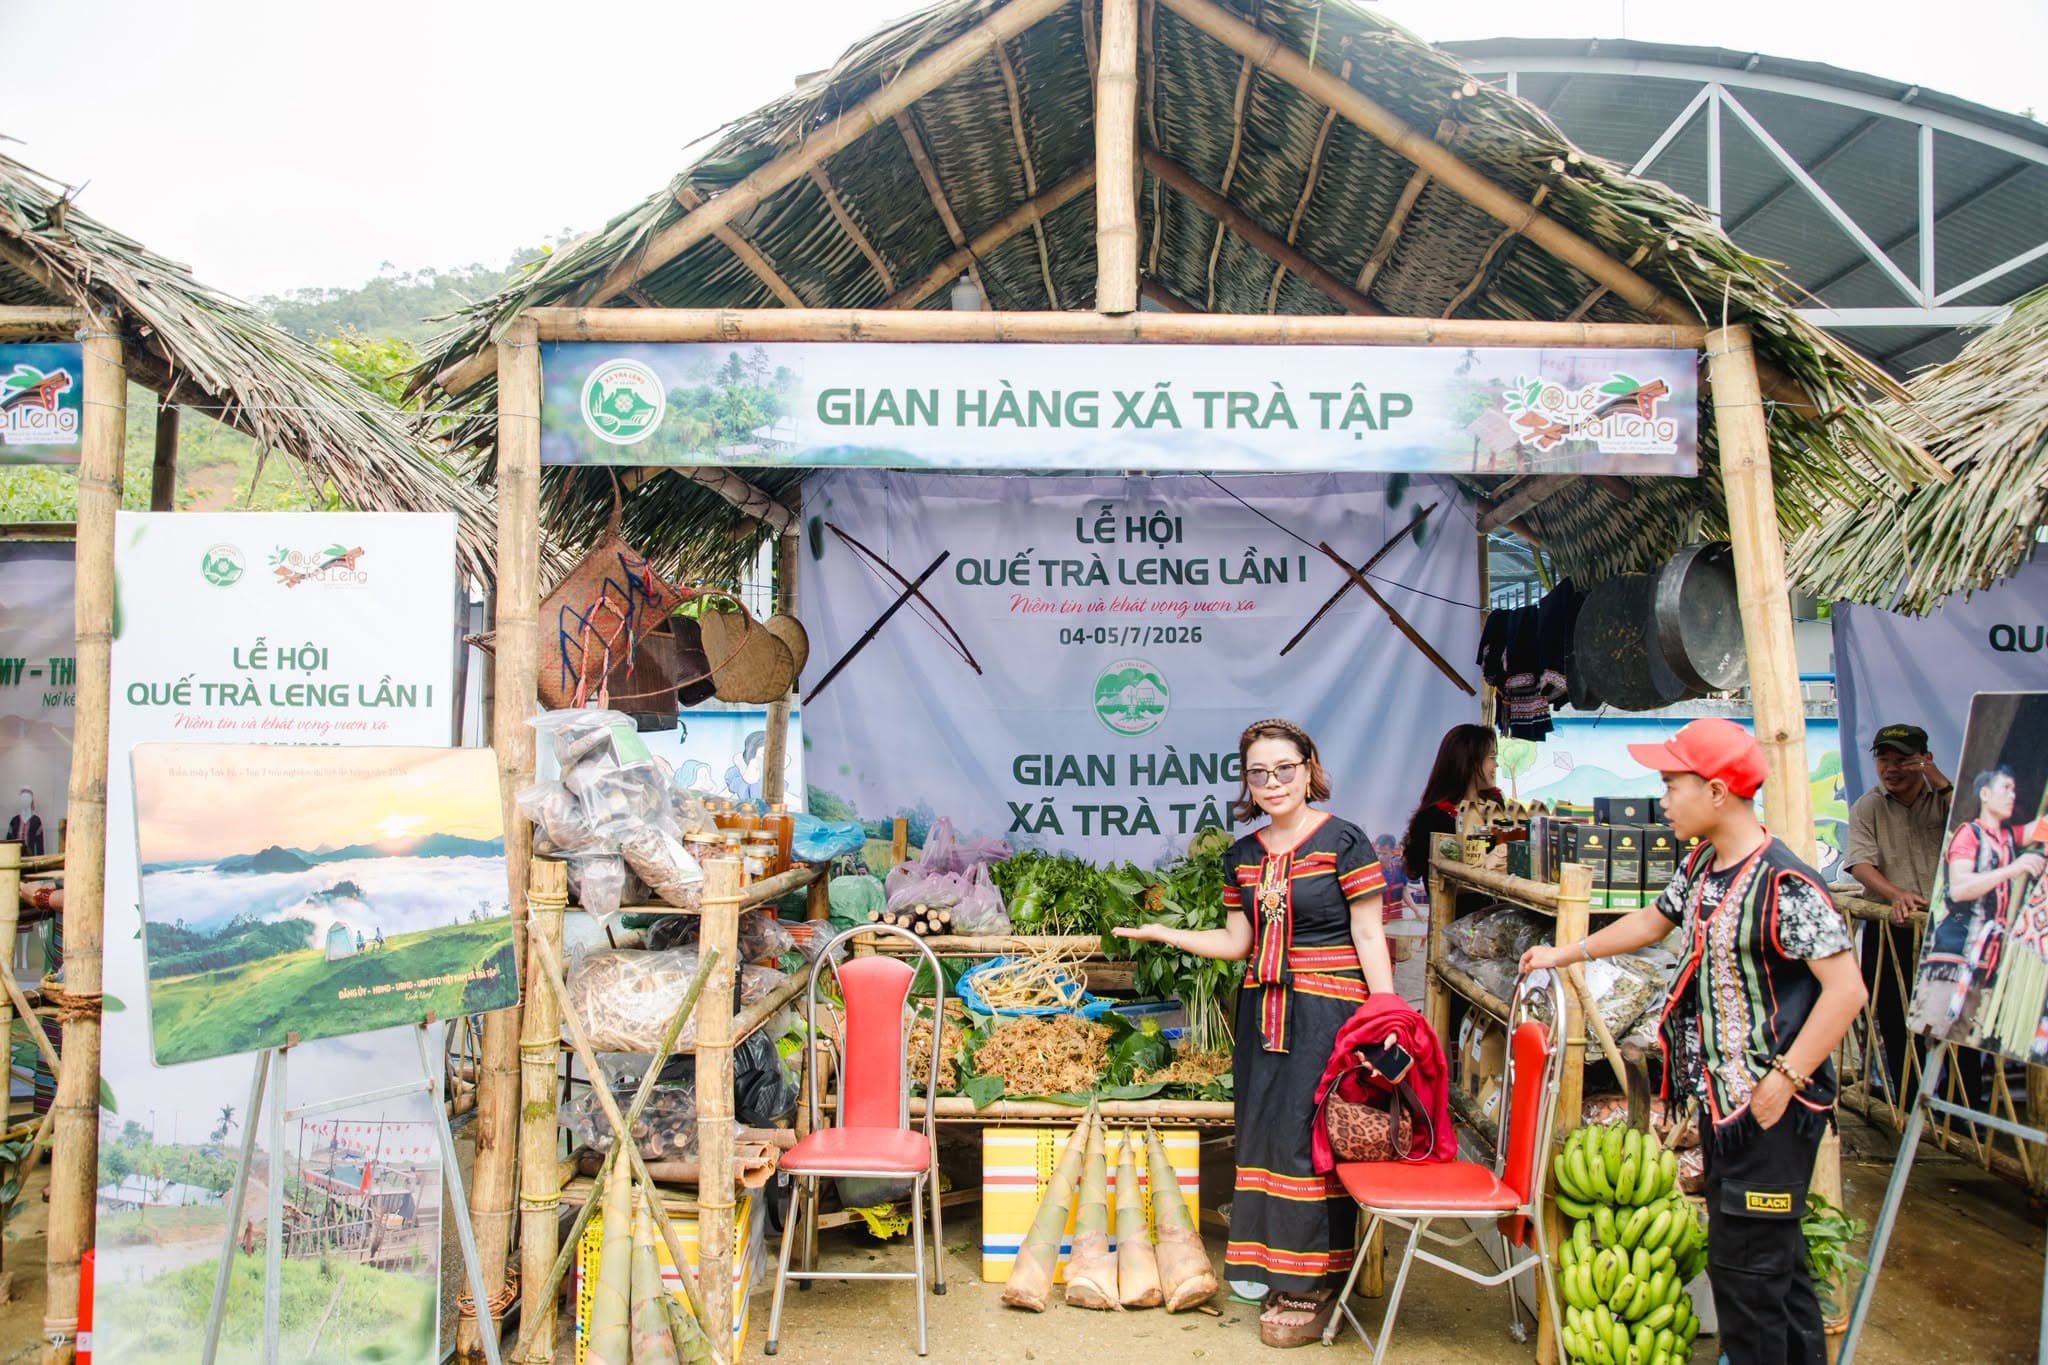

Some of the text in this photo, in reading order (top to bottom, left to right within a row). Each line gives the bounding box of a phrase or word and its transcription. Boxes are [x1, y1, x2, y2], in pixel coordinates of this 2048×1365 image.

[816, 380, 1414, 440] GIAN HÀNG XÃ TRÀ TẬP
[1540, 386, 1597, 413] Quế
[19, 404, 75, 432] Leng
[1568, 413, 1675, 442] Trà Leng
[1076, 504, 1183, 549] LỄ HỘI
[956, 546, 1307, 586] QUẾ TRÀ LENG LẦN I
[1060, 599, 1082, 613] tin
[1087, 598, 1106, 613] và
[1109, 594, 1147, 613] khát
[1150, 599, 1188, 619] vọng
[1235, 600, 1257, 613] xa
[1059, 627, 1203, 646] 04-05/7/2026
[1989, 624, 2048, 653] QU
[233, 636, 328, 676] LỄ HỘI
[127, 673, 432, 707] QUẾ TRÀ LENG LẦN I
[217, 716, 237, 729] tin
[241, 716, 258, 729] và
[371, 720, 389, 731] xa
[1013, 745, 1243, 786] GIAN HÀNG
[1007, 797, 1064, 834] XÃ
[1072, 797, 1160, 835] TRÀ
[1751, 1196, 1788, 1209] BLACK
